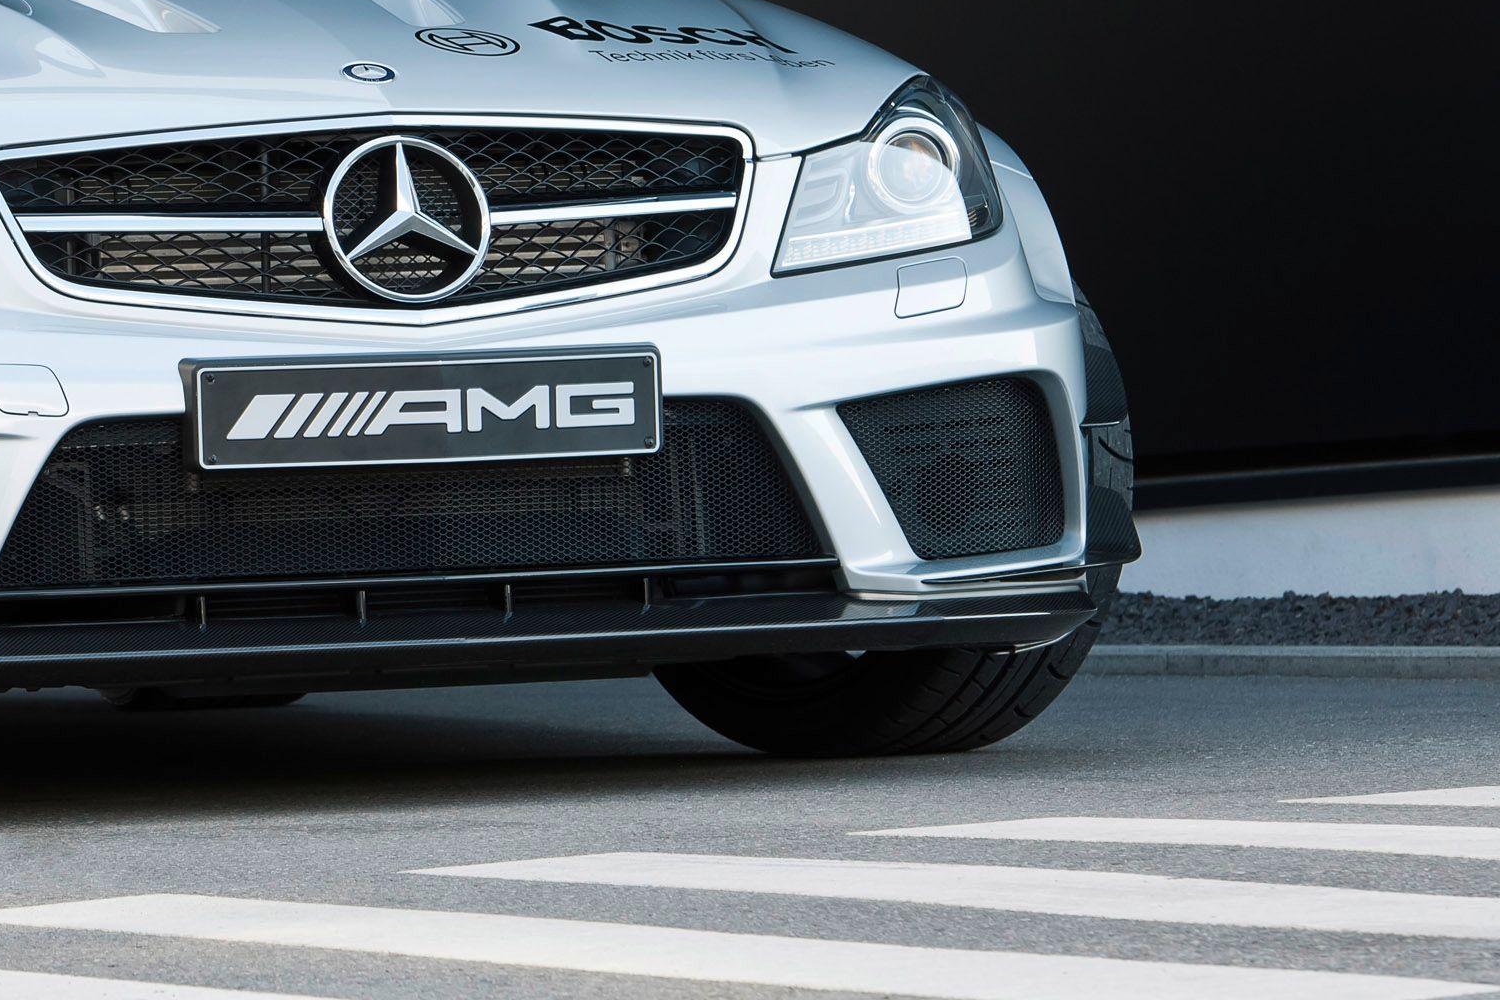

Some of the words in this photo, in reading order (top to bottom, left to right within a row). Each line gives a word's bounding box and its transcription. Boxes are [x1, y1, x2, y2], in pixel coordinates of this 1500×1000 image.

[528, 15, 797, 55] BOSCH
[588, 50, 698, 63] Technik
[697, 49, 756, 62] fürs
[752, 51, 836, 69] Leben
[364, 381, 637, 437] AMG
